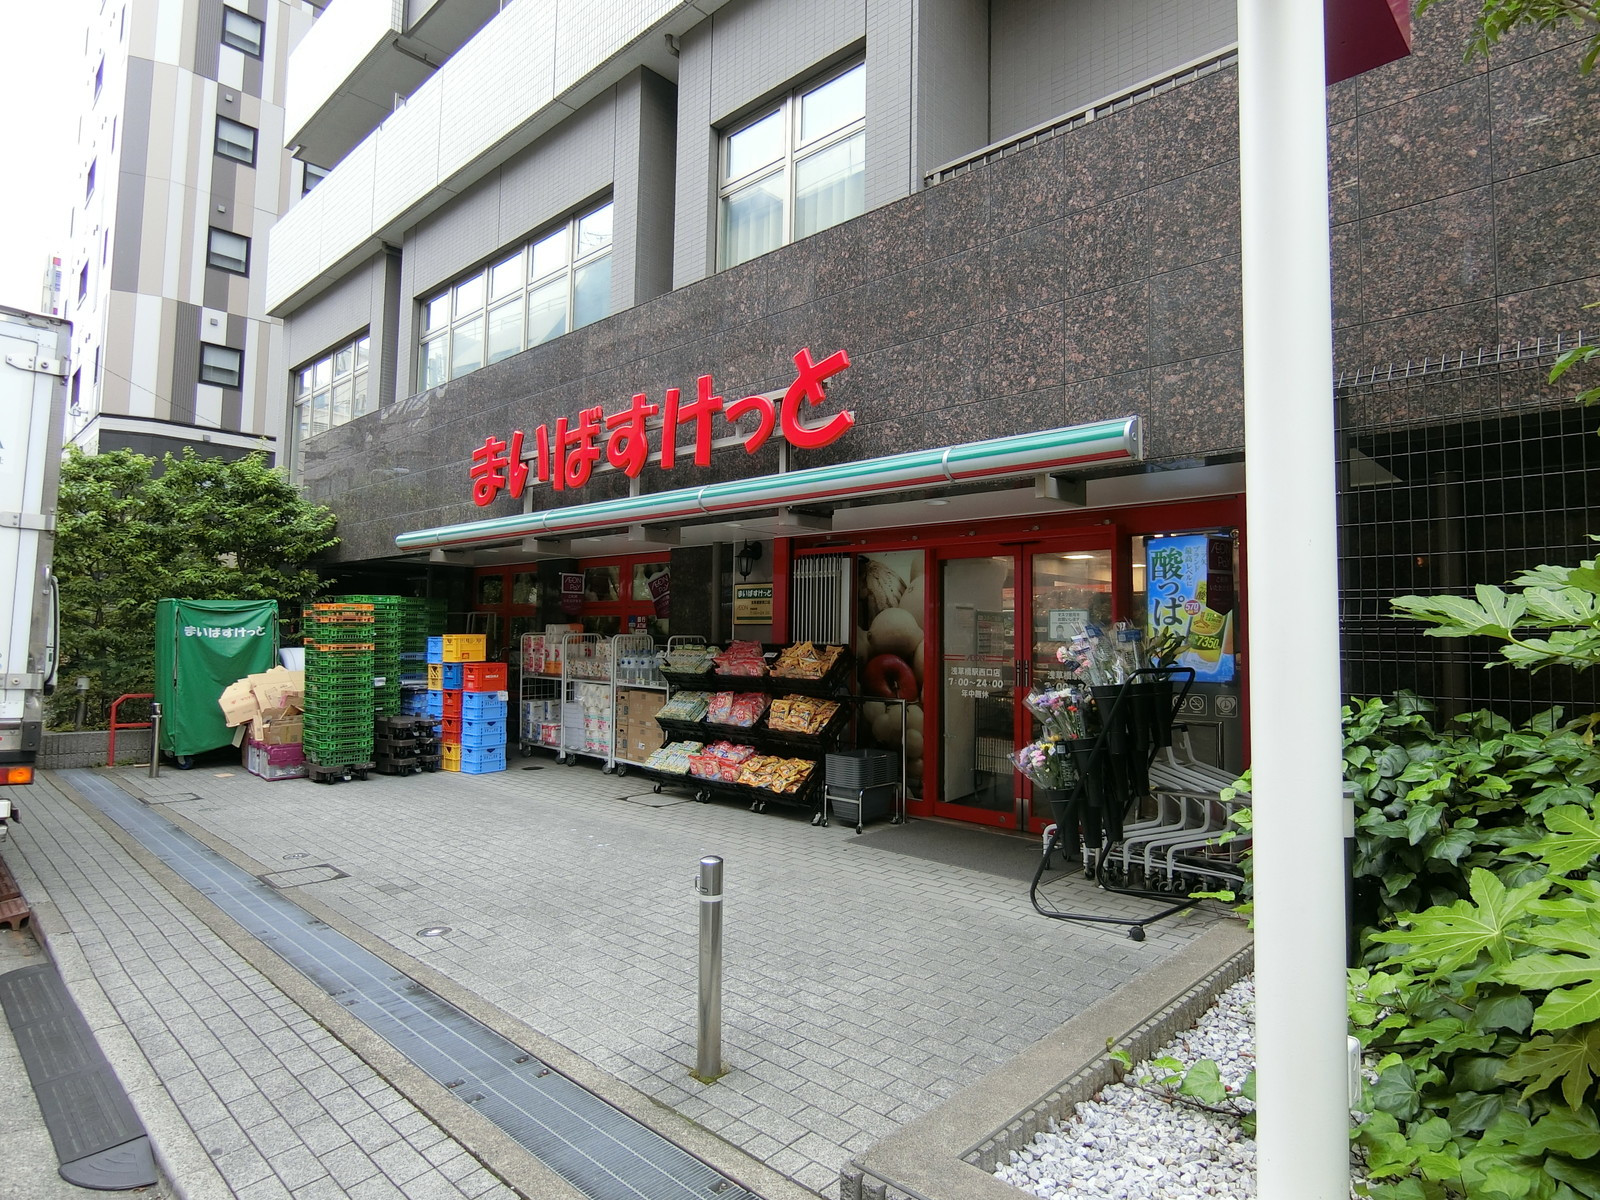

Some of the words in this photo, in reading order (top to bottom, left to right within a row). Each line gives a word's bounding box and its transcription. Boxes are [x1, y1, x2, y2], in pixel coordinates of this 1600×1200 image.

[470, 347, 854, 507] まいばすけっと
[738, 589, 772, 598] まいばすけっと
[1150, 547, 1185, 636] 酸っぱ
[1185, 602, 1199, 611] 570
[184, 625, 267, 638] まいばすけっと
[950, 667, 1001, 677] 浅草橋駅西口店
[961, 689, 989, 699] 年中無休
